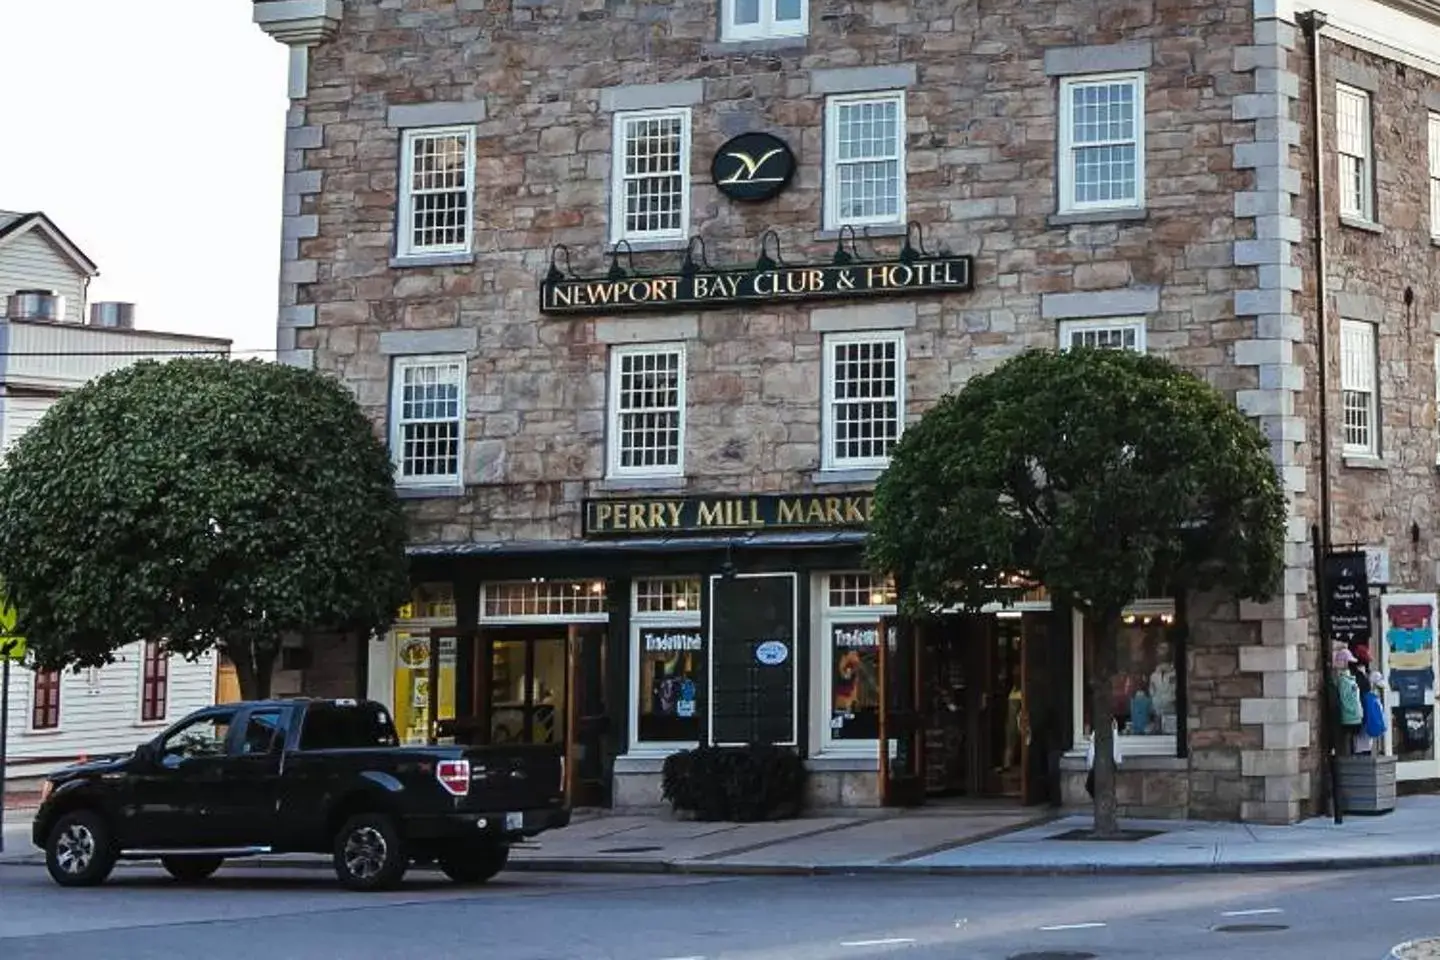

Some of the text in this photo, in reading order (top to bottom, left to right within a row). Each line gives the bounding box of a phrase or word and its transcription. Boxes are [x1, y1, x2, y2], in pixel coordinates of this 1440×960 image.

[552, 261, 959, 308] NEWPORT BAY CLUB & HOTEL
[596, 500, 685, 531] PERRY
[697, 499, 765, 527] MILL
